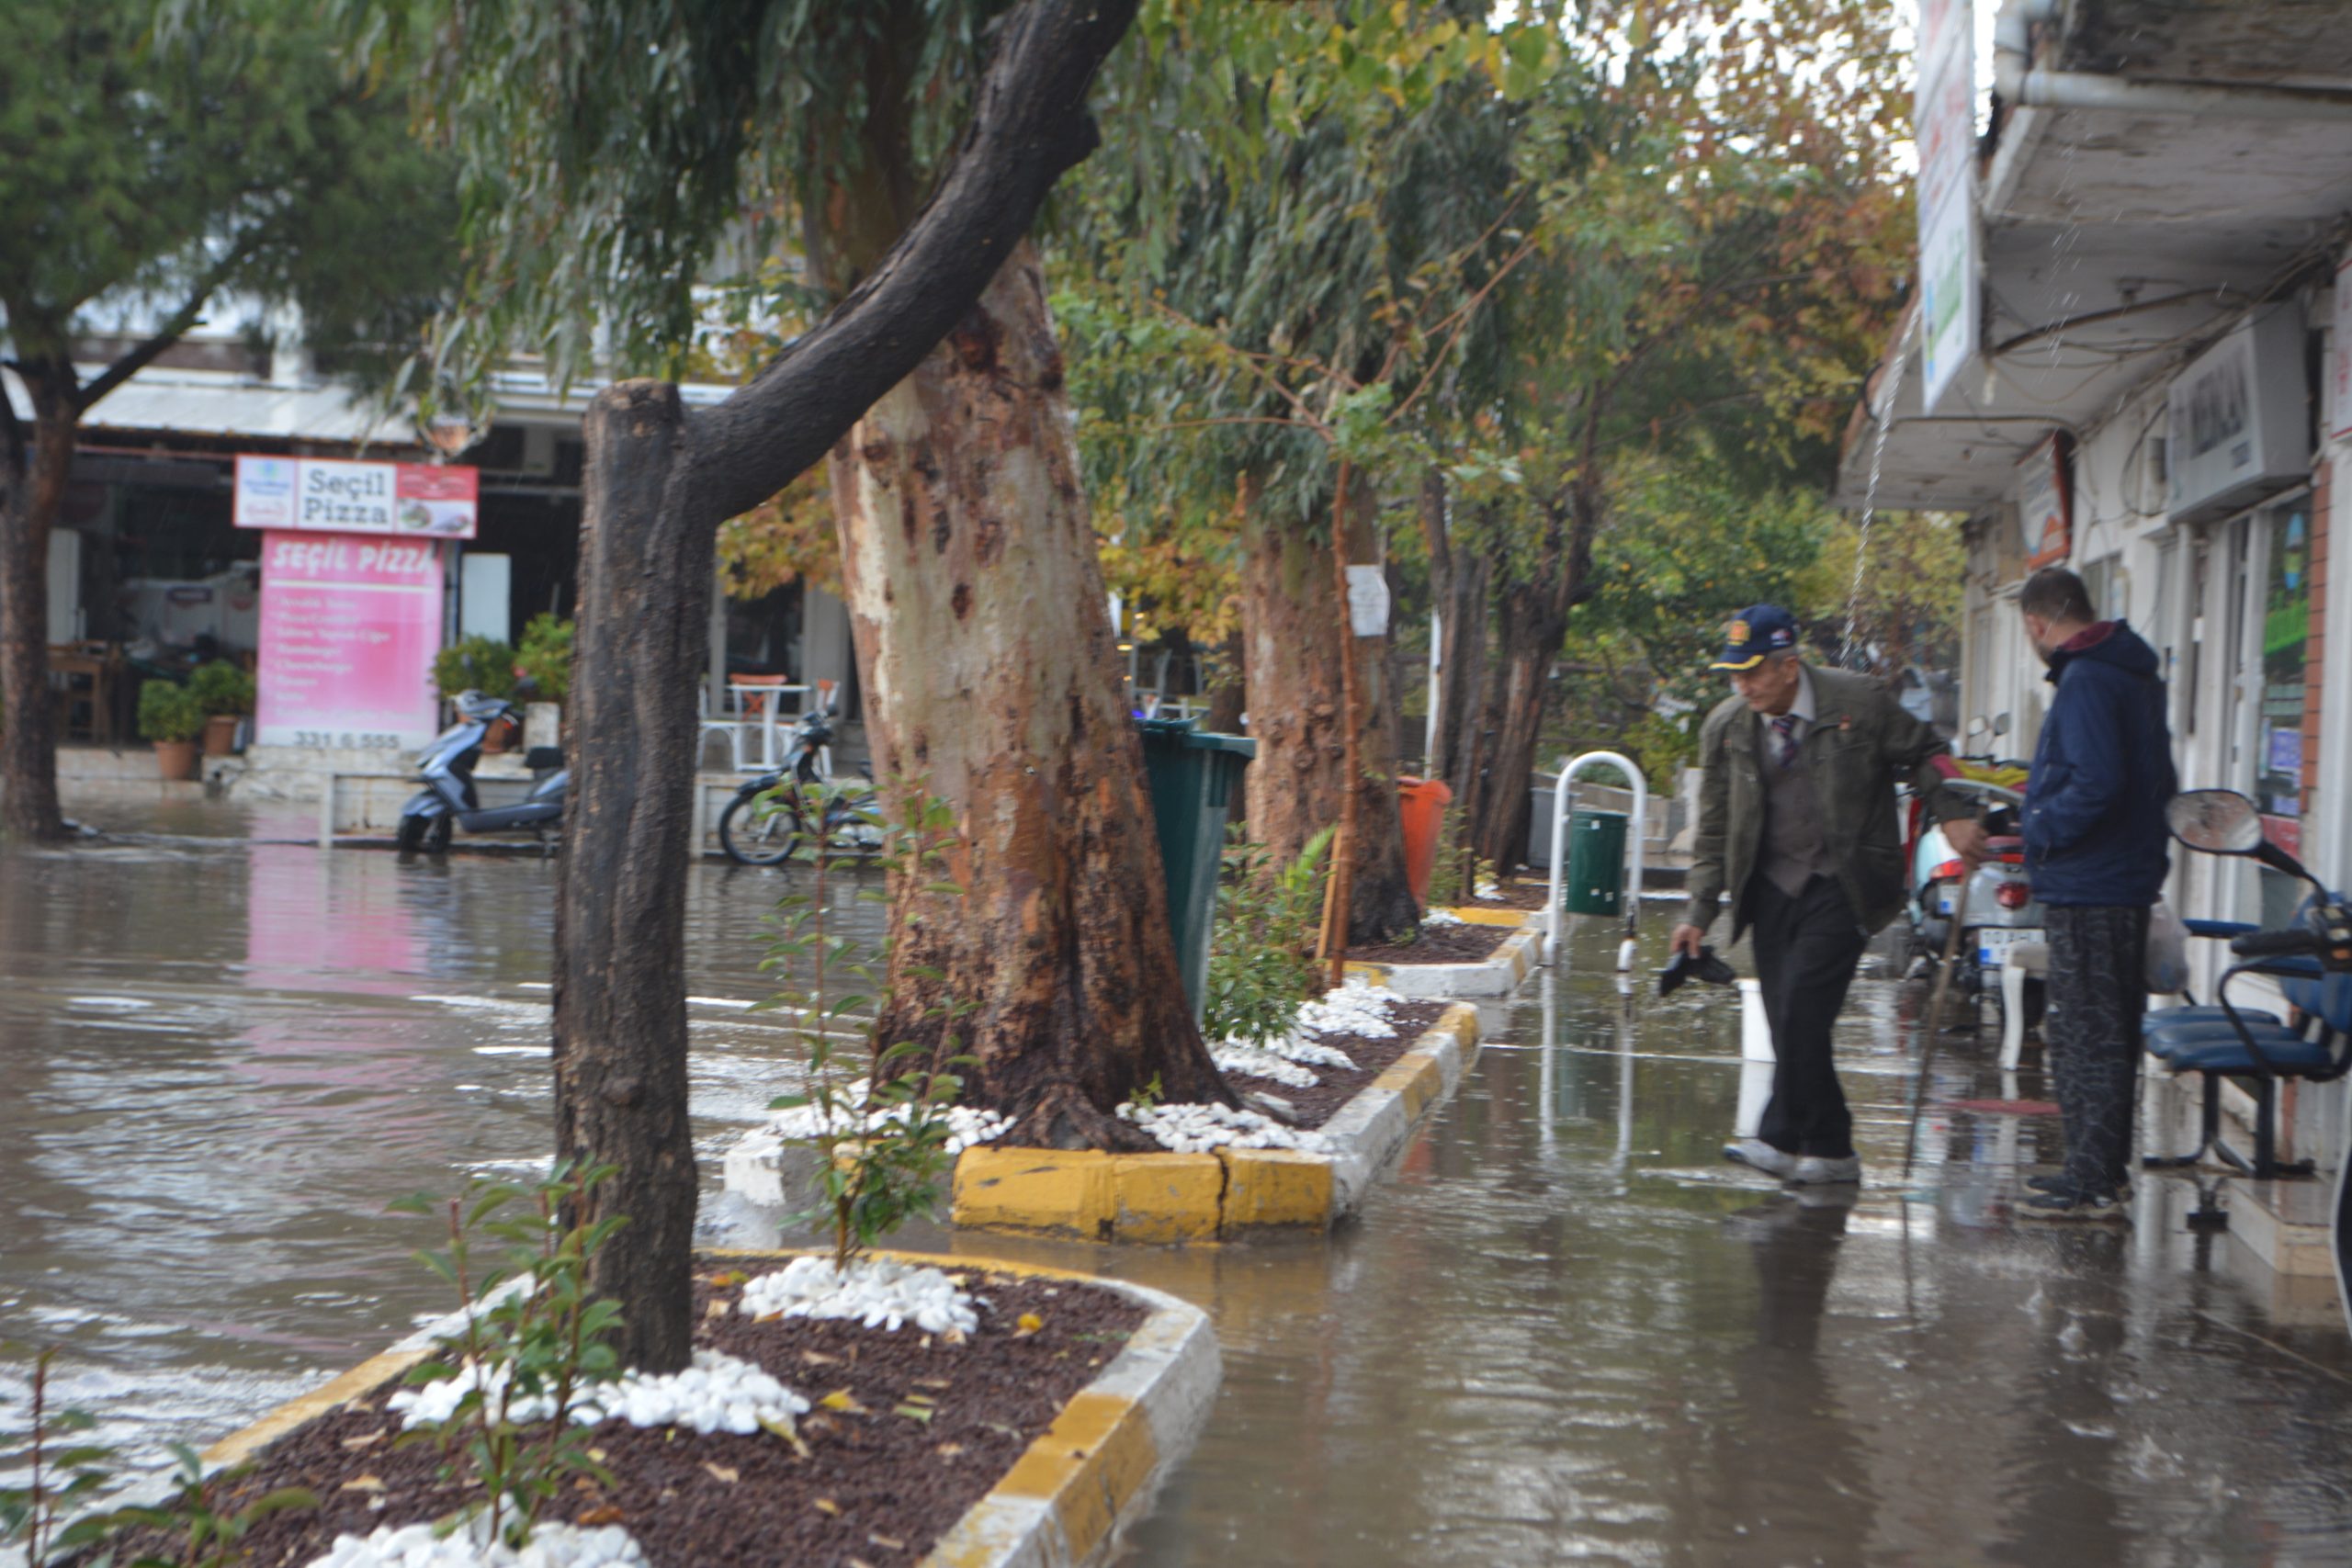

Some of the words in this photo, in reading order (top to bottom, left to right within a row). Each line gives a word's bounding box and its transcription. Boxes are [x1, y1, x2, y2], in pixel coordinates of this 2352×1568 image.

[308, 468, 385, 502] Seçil
[304, 497, 388, 524] Pizza
[272, 538, 348, 577] SEÇİL
[357, 540, 434, 574] PİZZA
